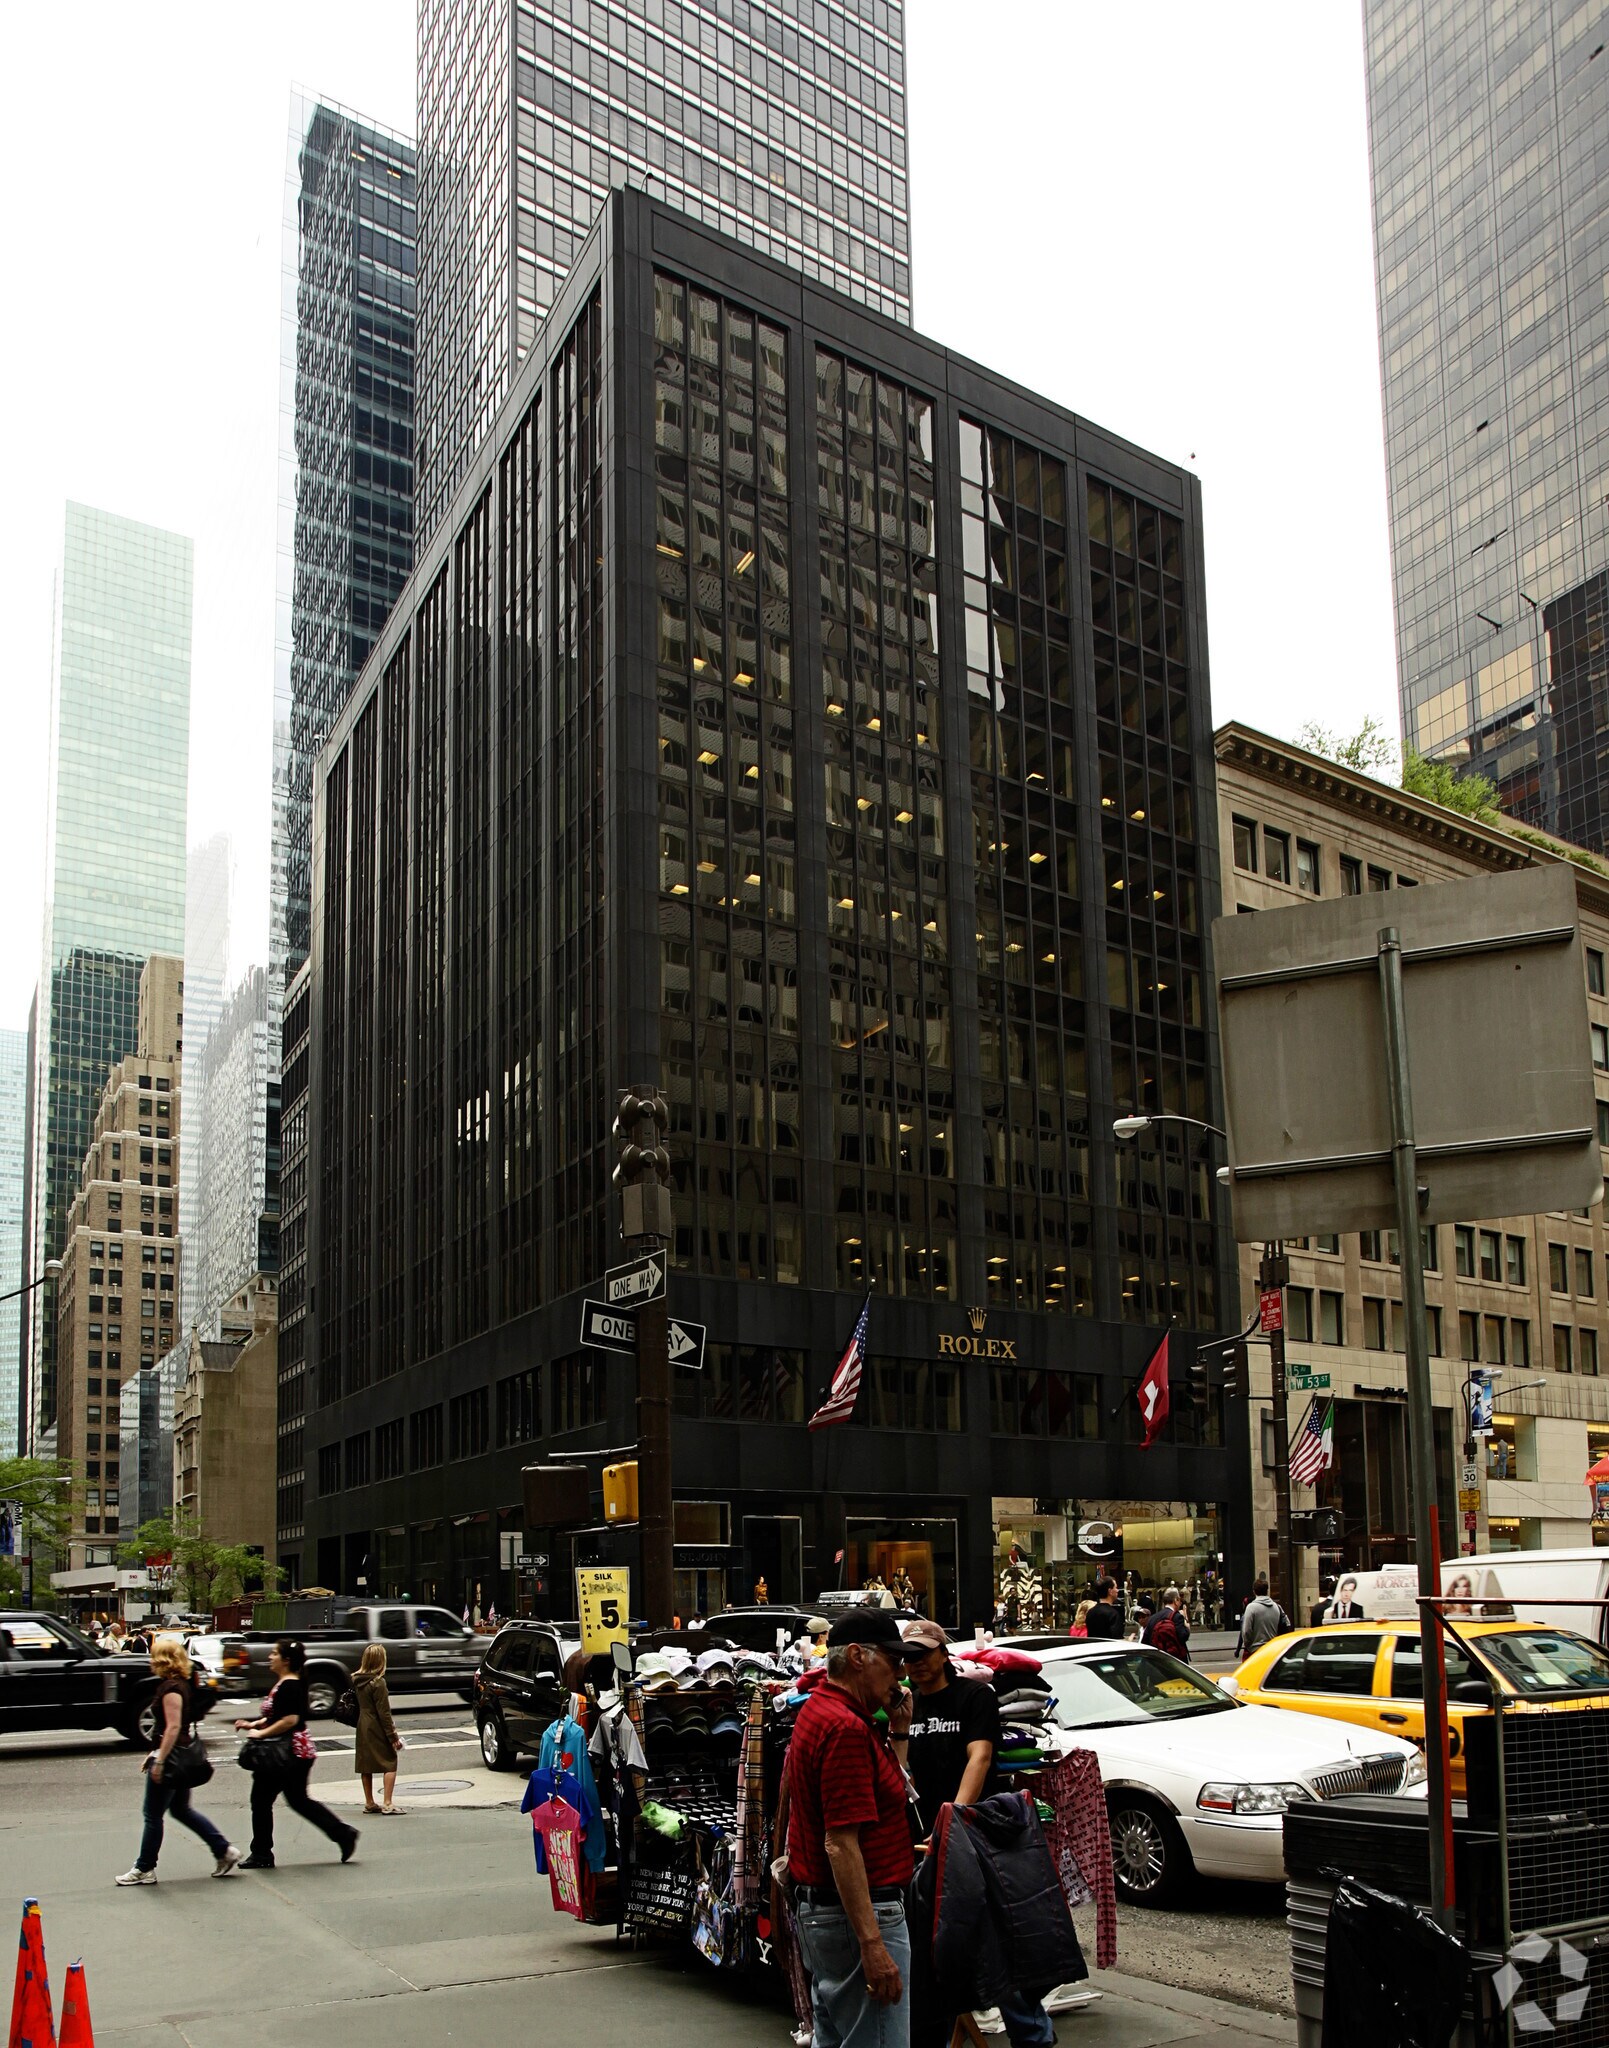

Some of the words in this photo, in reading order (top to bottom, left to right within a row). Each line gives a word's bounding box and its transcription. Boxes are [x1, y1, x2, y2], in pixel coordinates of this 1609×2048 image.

[614, 1277, 631, 1297] ONE
[639, 1268, 657, 1290] WAY
[601, 1318, 635, 1340] ONE
[667, 1332, 686, 1350] AY
[938, 1334, 1017, 1359] ROLEX
[1293, 1366, 1300, 1376] 5
[1296, 1379, 1304, 1390] W
[1307, 1377, 1320, 1388] 53
[1464, 1473, 1476, 1482] 30
[14, 1499, 23, 1526] MoMA
[594, 1573, 613, 1581] SILK
[580, 1574, 592, 1638] PASHMINA
[927, 1717, 961, 1734] Diem
[549, 1828, 573, 1857] NEW
[557, 1880, 580, 1907] CITY
